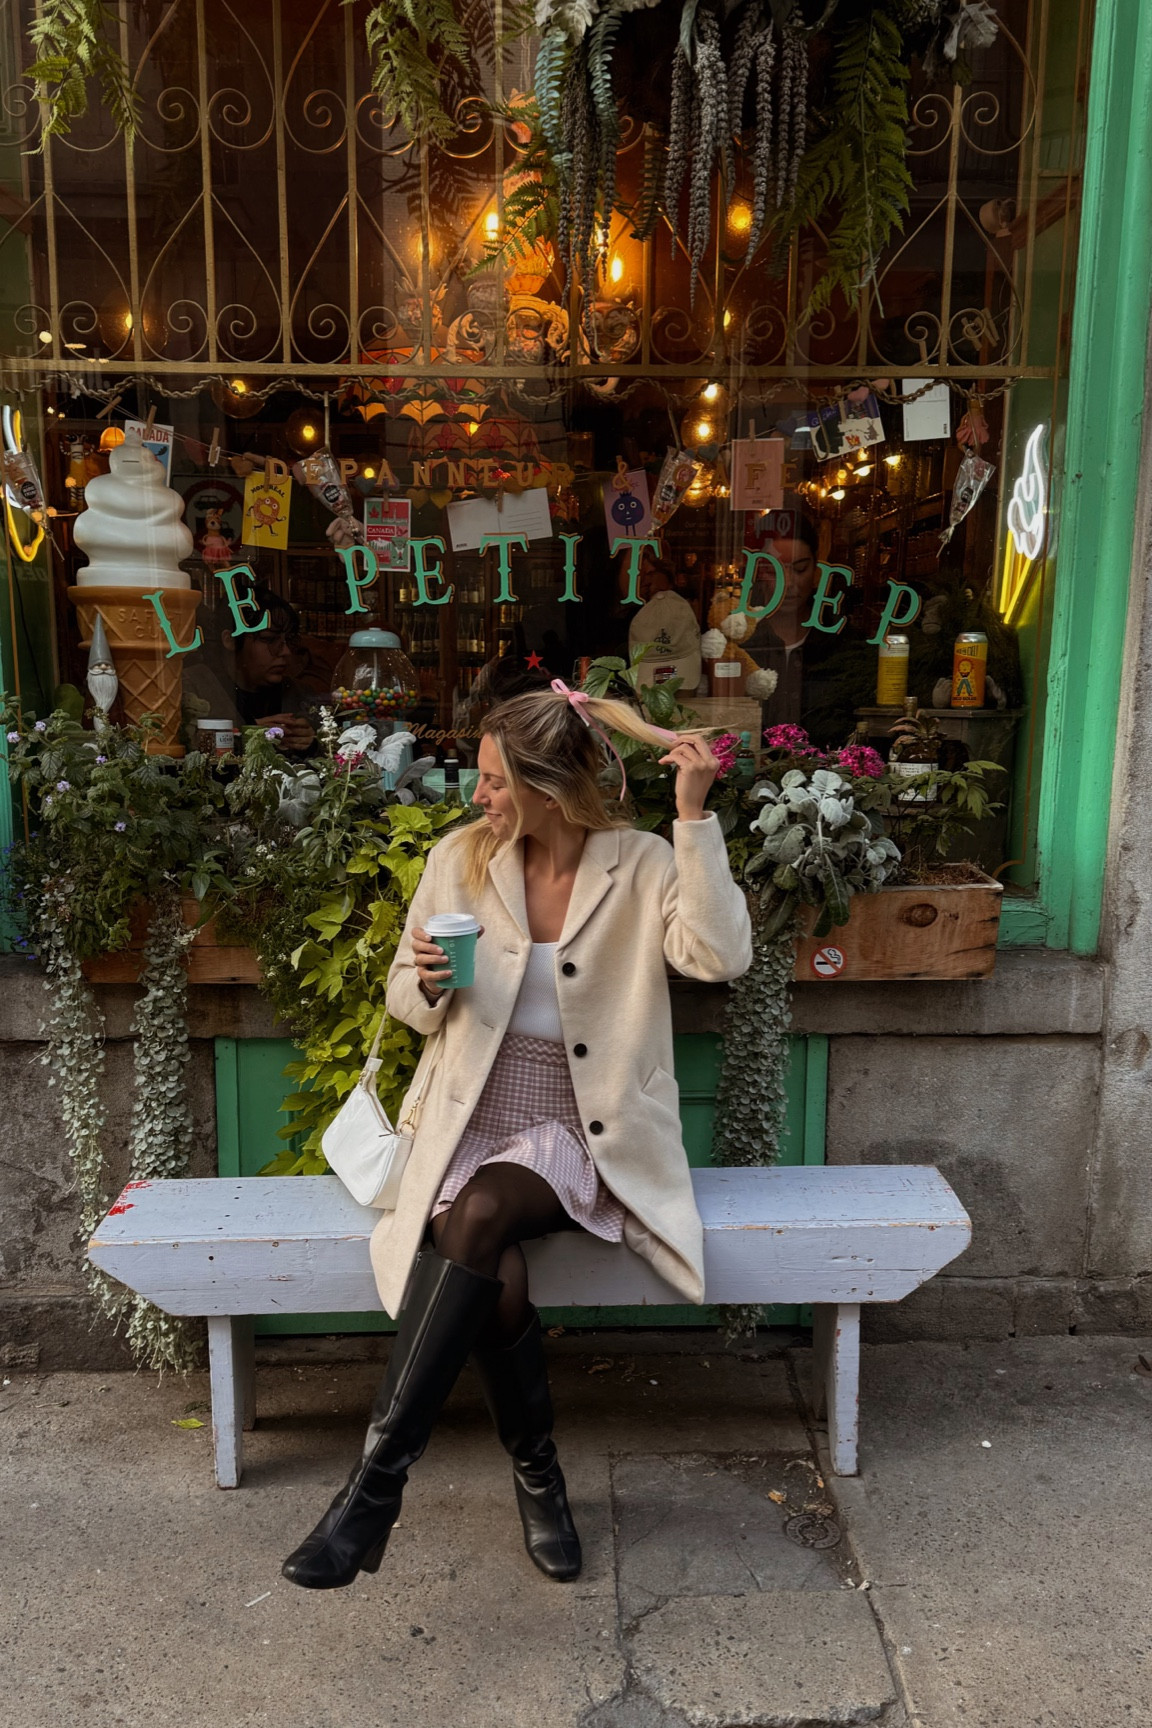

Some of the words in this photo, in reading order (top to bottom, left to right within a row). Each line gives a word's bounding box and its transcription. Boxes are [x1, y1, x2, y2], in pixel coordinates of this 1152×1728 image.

[250, 484, 285, 498] MONRÉAL
[142, 563, 270, 658] LE
[334, 532, 663, 615] PETIT
[731, 549, 922, 648] DEP
